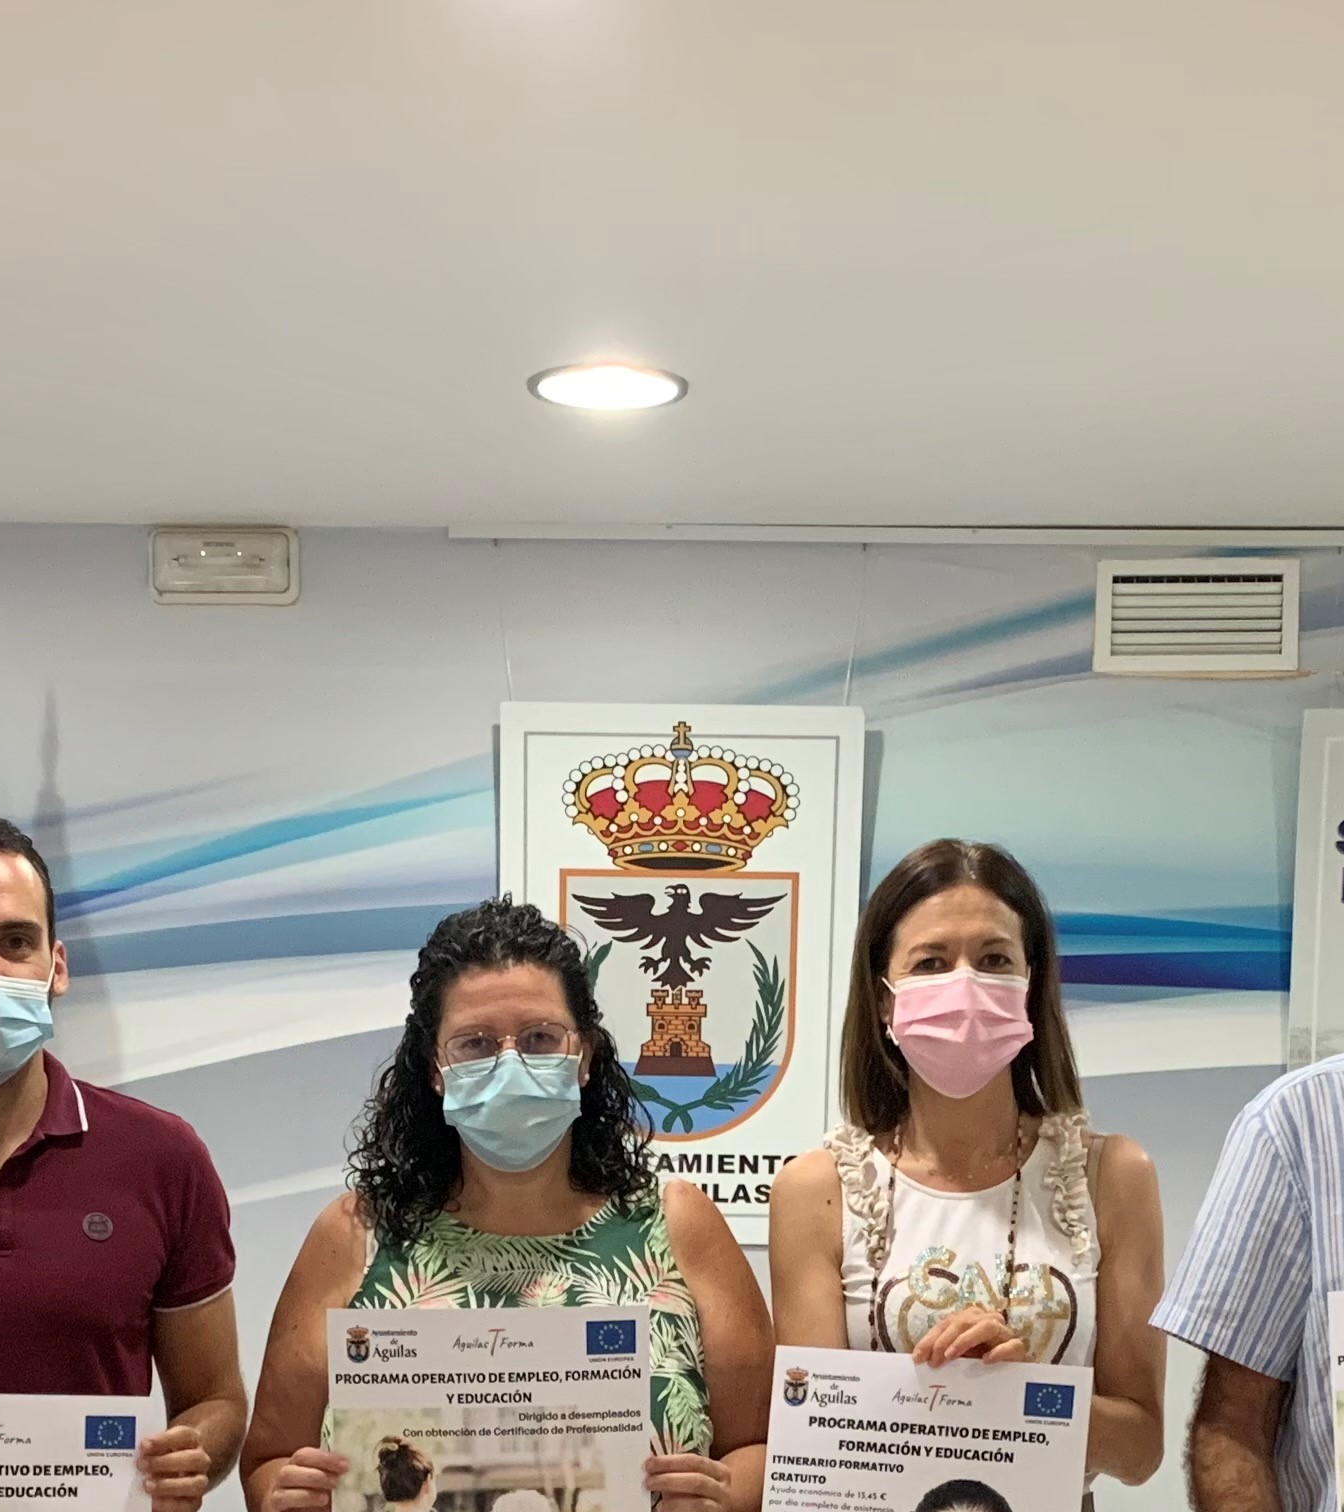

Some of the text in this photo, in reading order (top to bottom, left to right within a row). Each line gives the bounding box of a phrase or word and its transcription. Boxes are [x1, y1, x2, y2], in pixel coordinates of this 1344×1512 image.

[335, 1373, 409, 1384] PROGRAMA
[411, 1372, 486, 1384] OPERATIVO
[488, 1372, 505, 1383] DE
[564, 1366, 641, 1381] FORMACIÓN
[445, 1389, 532, 1404] Y EDUCACIÓN
[808, 1416, 887, 1431] PROGRAMA
[889, 1422, 969, 1438] OPERATIVO
[971, 1427, 990, 1439] DE
[838, 1439, 1014, 1462] FORMACIÓN Y EDUCACIÓN
[32, 1464, 51, 1476] DE
